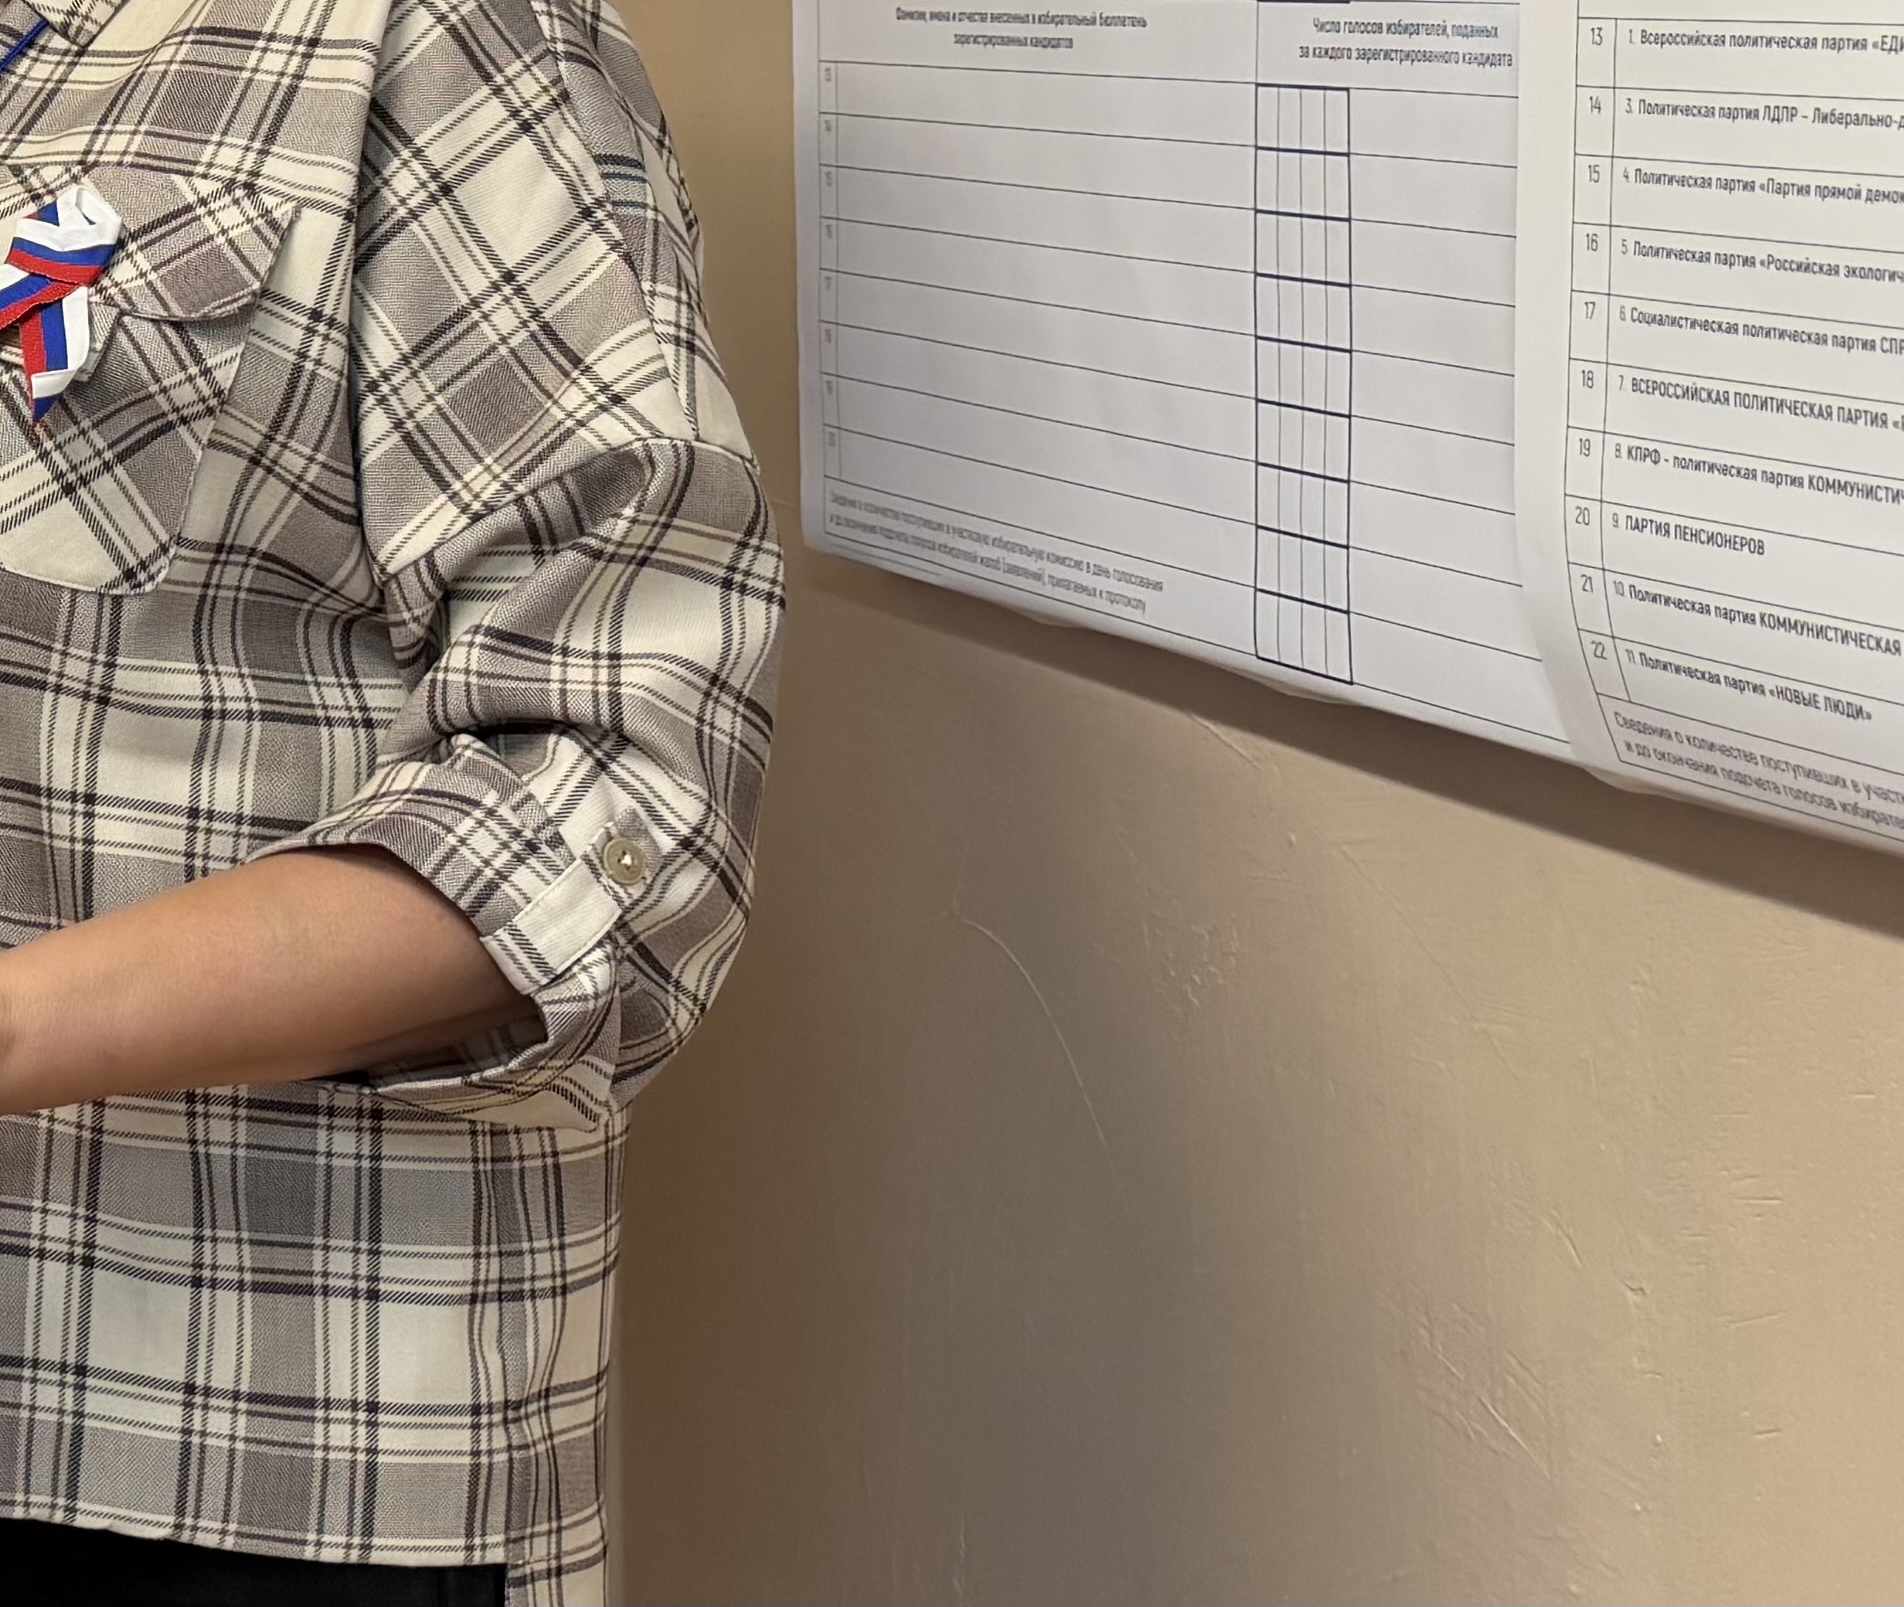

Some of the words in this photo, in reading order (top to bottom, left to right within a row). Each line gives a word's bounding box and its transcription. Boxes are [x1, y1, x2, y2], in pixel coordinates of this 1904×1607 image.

[1313, 17, 1341, 33] Число
[1344, 20, 1383, 34] голосов
[1386, 19, 1449, 39] избирателей,
[1452, 24, 1498, 39] поданных
[1299, 46, 1309, 58] за
[1312, 46, 1352, 61] каждого
[1355, 47, 1459, 65] зарегистрированного
[1462, 52, 1513, 68] кандидата
[1581, 371, 1594, 388] 18
[1631, 377, 1730, 408] ВСЕРОССИЙСКАЯ
[1734, 390, 1832, 422] ПОЛИТИЧЕСКАЯ
[1837, 406, 1888, 430] ПАРТИЯ
[1575, 508, 1590, 526] 20
[1625, 515, 1670, 538] ПАРТИЯ
[1674, 525, 1765, 556] ПЕНСИОНЕРОВ
[1590, 641, 1607, 661] 22
[1639, 652, 1720, 686] Политическая
[1724, 674, 1765, 698] партия
[1769, 684, 1820, 710] «НОВЫЕ
[1824, 697, 1872, 722] ЛЮДИ»
